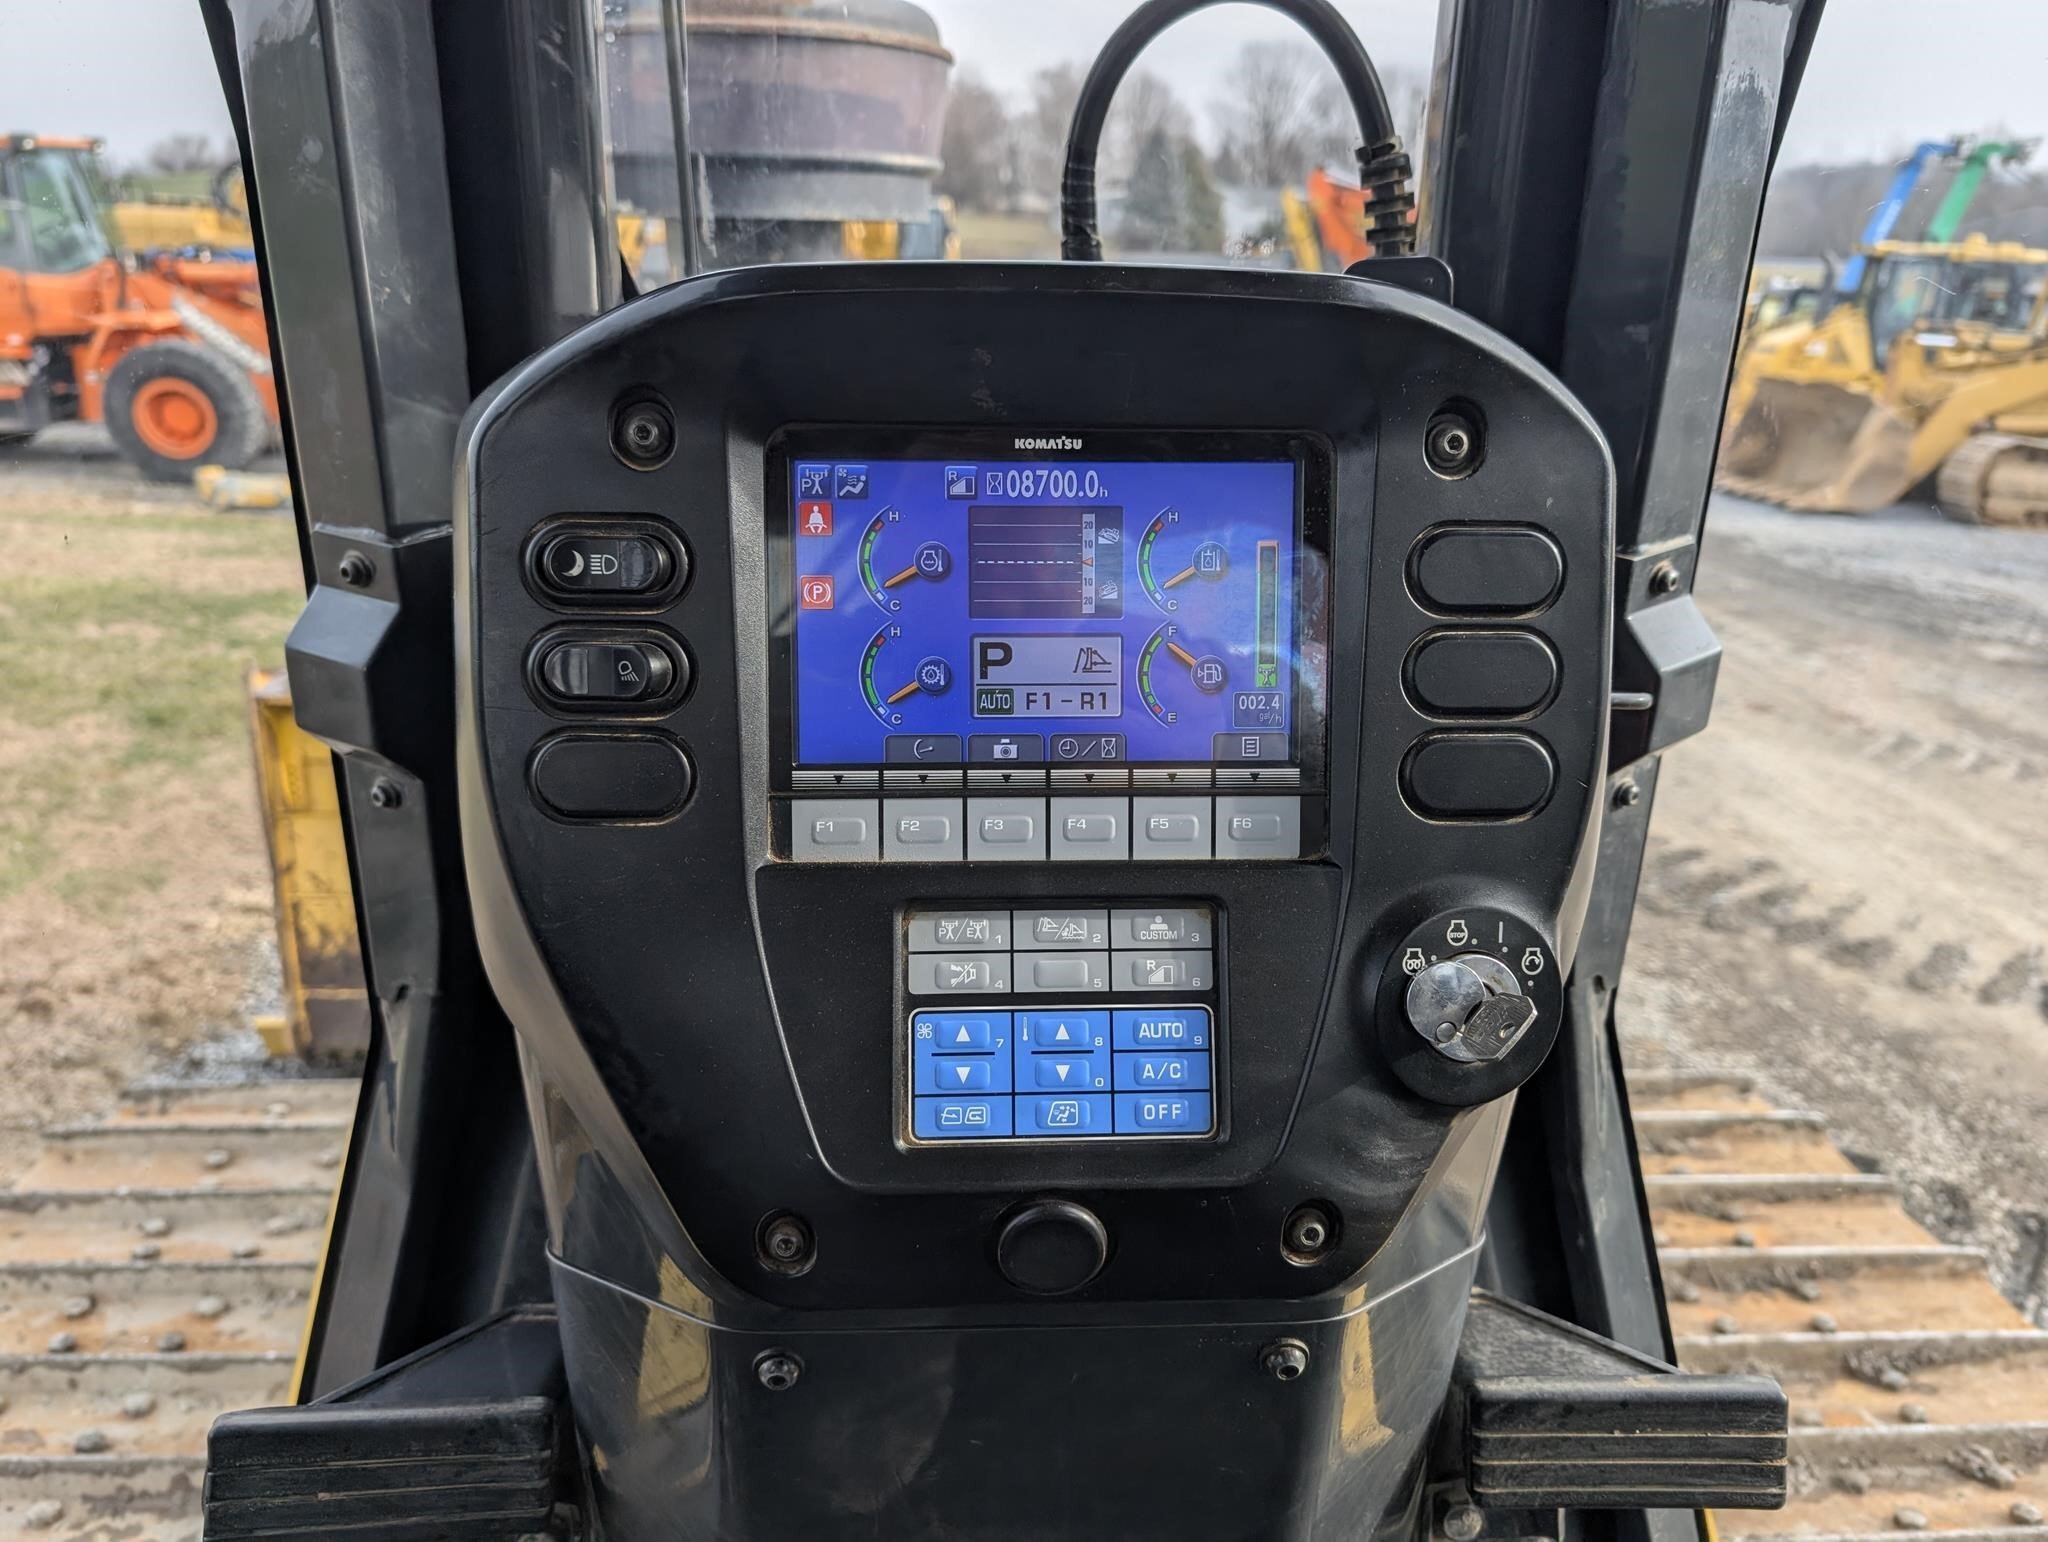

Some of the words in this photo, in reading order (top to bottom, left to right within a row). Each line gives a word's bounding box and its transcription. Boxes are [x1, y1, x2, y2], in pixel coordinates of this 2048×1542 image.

[1015, 436, 1082, 450] KOMATSU
[949, 471, 957, 481] R
[889, 511, 898, 521] H
[1168, 512, 1179, 522] H
[1083, 520, 1094, 530] 20
[1084, 539, 1094, 549] 10
[1084, 577, 1094, 587] 10
[814, 585, 824, 597] P
[890, 600, 900, 610] C
[1083, 596, 1094, 606] 20
[1167, 600, 1177, 610] C
[891, 627, 900, 637] H
[1168, 626, 1177, 636] F
[980, 641, 1012, 679] P
[1239, 696, 1280, 710] 002.4
[891, 714, 902, 724] C
[1168, 712, 1177, 722] E
[816, 821, 834, 832] F1
[901, 820, 920, 831] F2
[984, 820, 1004, 830] F3
[1068, 819, 1087, 829] F4
[1151, 818, 1169, 829] F5
[1233, 818, 1252, 829] F6
[995, 935, 1002, 944] 1
[1093, 933, 1101, 943] 2
[1140, 930, 1178, 940] CUSTOM
[1192, 933, 1200, 942] 3
[1146, 960, 1156, 970] R
[995, 980, 1003, 989] 4
[1094, 978, 1102, 988] 5
[1193, 977, 1201, 987] 6
[1139, 1023, 1183, 1038] AUTO
[996, 1038, 1004, 1048] 7
[1095, 1036, 1103, 1046] 8
[1194, 1035, 1202, 1045] 9
[1142, 1063, 1182, 1079] A/C
[1144, 1104, 1182, 1119] OFF
